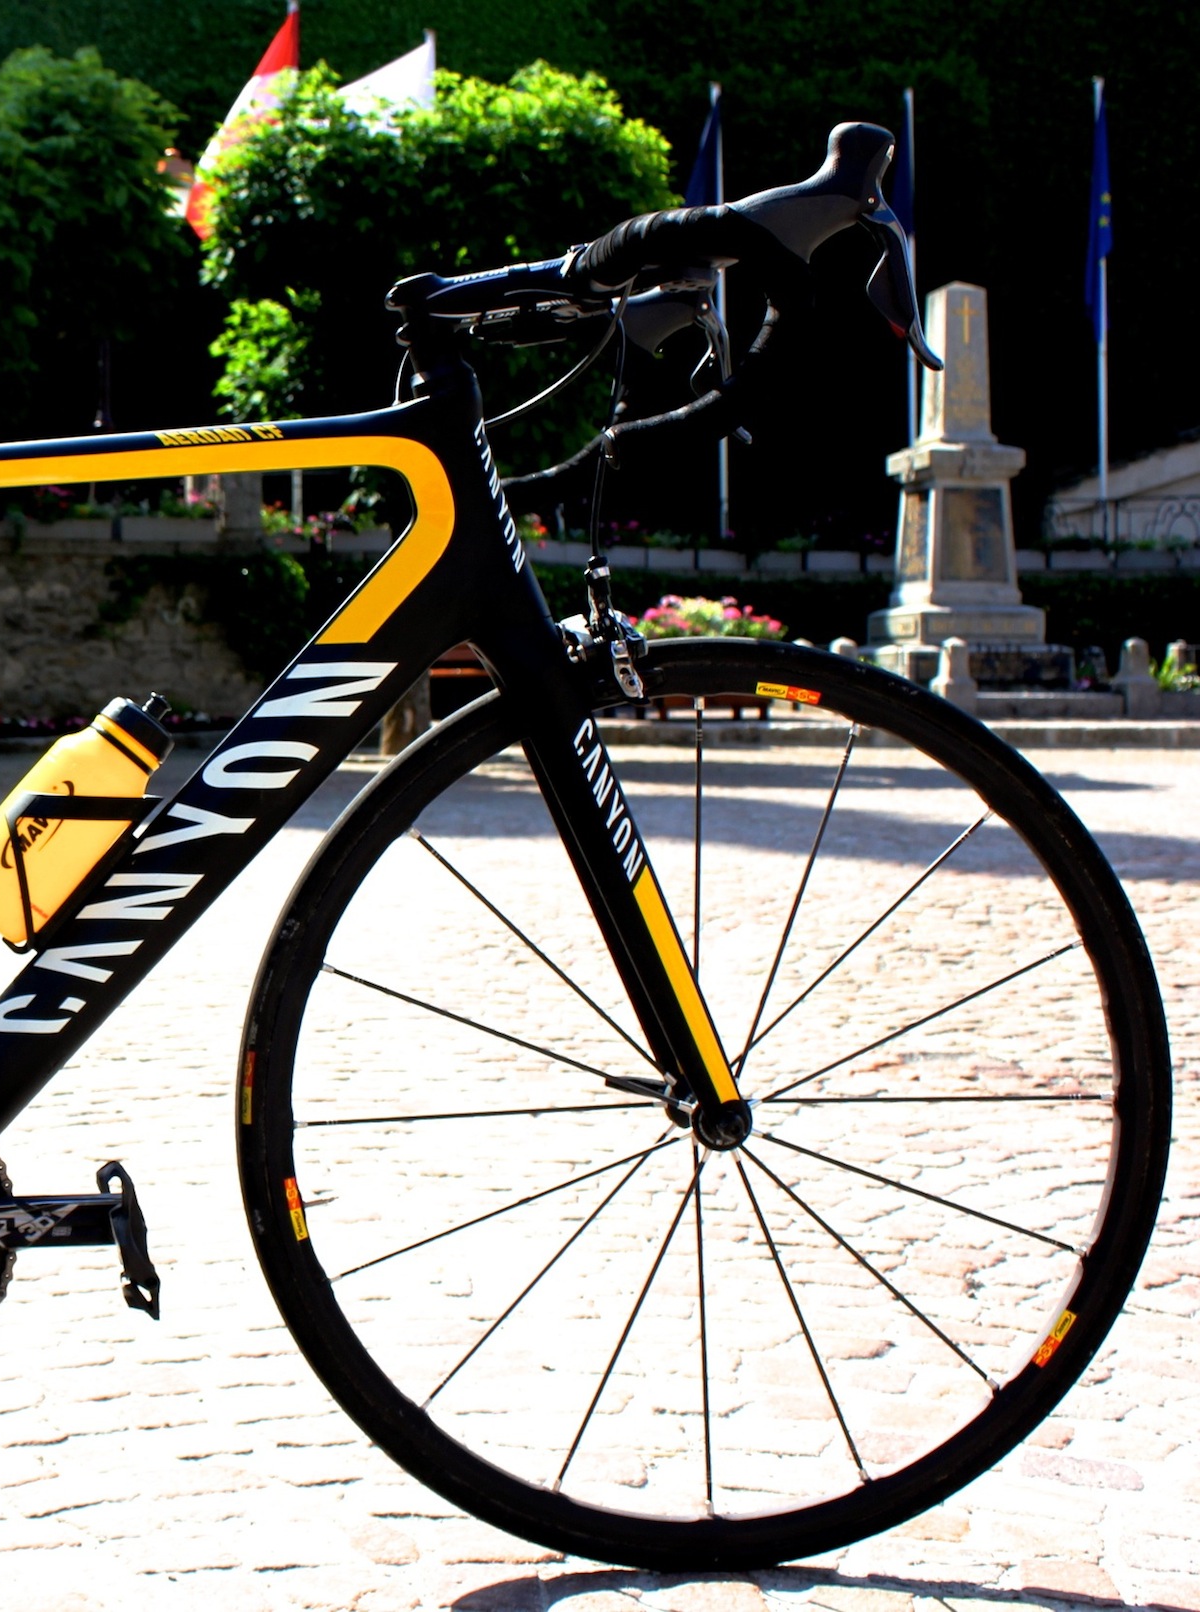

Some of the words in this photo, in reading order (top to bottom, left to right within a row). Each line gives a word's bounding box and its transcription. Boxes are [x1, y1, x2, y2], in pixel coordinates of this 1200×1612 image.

[154, 427, 252, 446] AEROAD
[250, 424, 284, 440] CF
[474, 417, 526, 574] CANYON
[572, 717, 644, 883] CANYON
